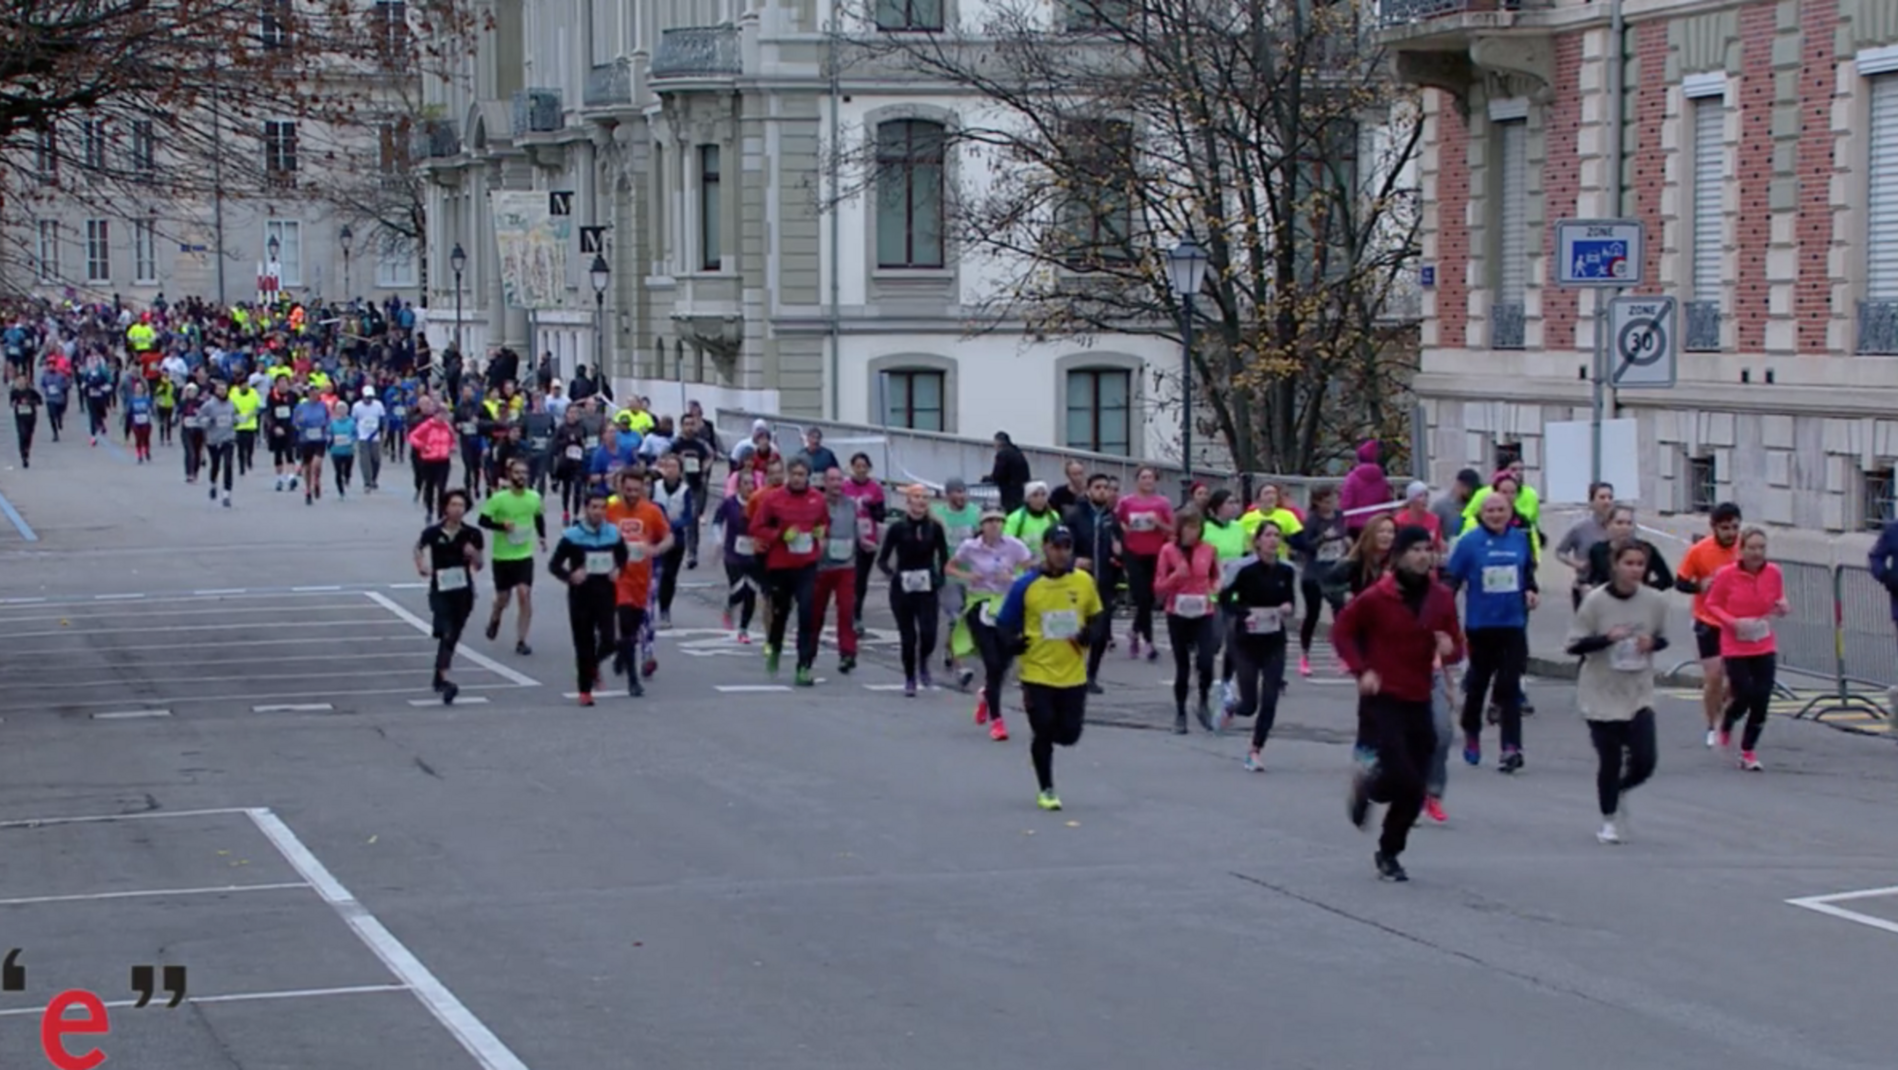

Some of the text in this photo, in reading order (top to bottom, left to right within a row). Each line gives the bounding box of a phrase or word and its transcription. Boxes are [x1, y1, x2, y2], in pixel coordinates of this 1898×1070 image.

[1586, 226, 1614, 237] ZONE
[1628, 304, 1656, 316] ZONE
[1631, 331, 1653, 351] 30
